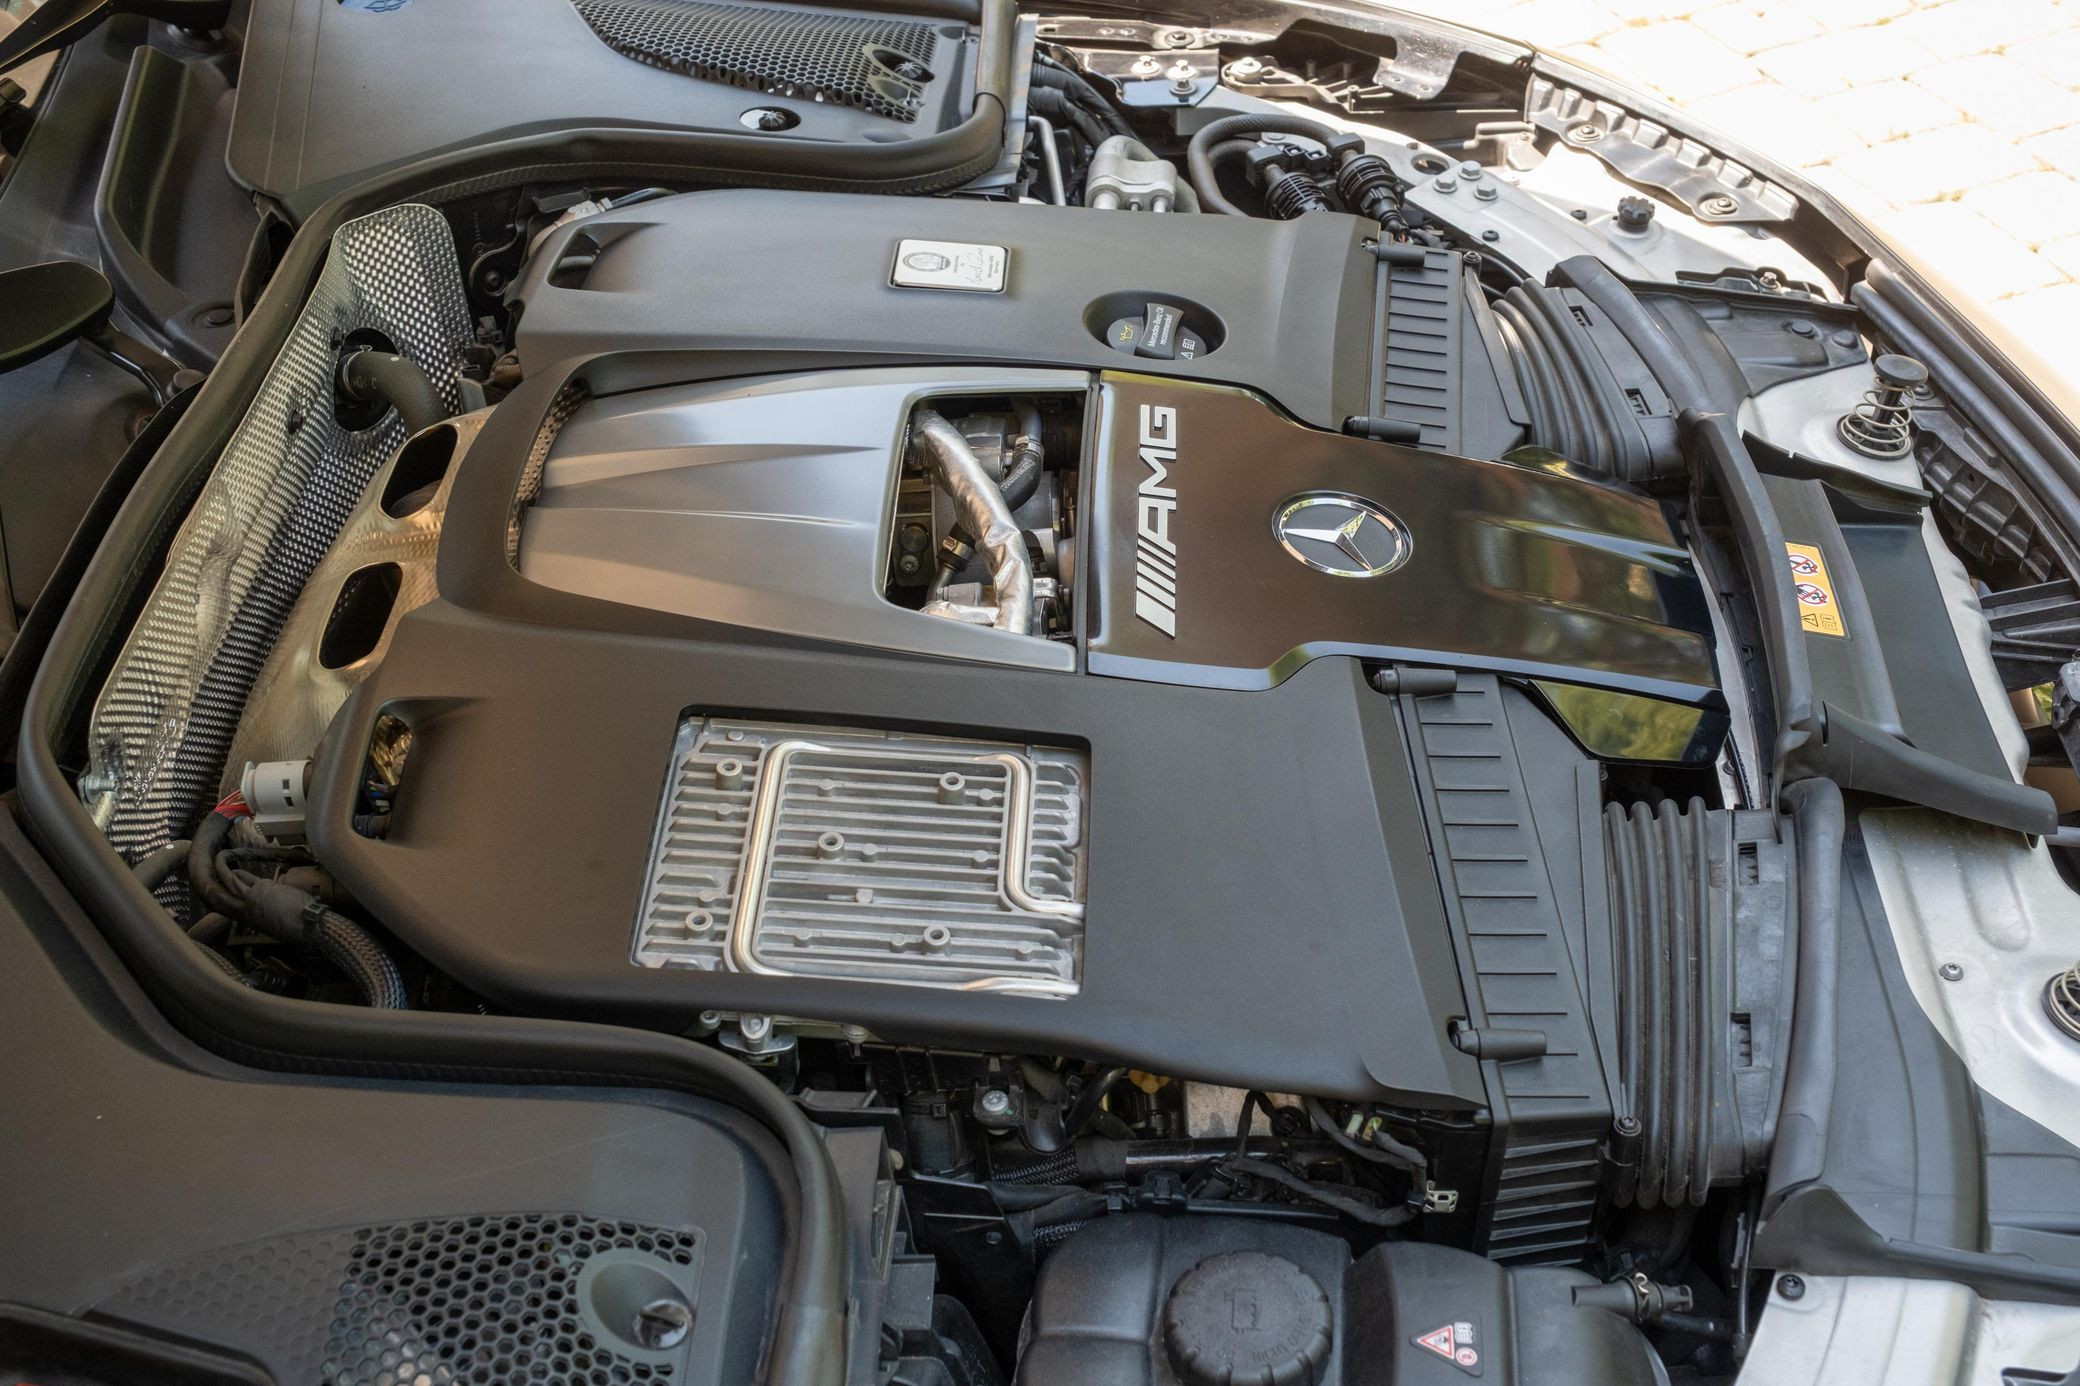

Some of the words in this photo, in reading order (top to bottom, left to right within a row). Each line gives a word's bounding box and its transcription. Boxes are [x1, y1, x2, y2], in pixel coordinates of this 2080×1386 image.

[1147, 313, 1163, 347] Mercedes-Benz
[1160, 313, 1173, 346] recommended
[1138, 404, 1177, 556] AMG
